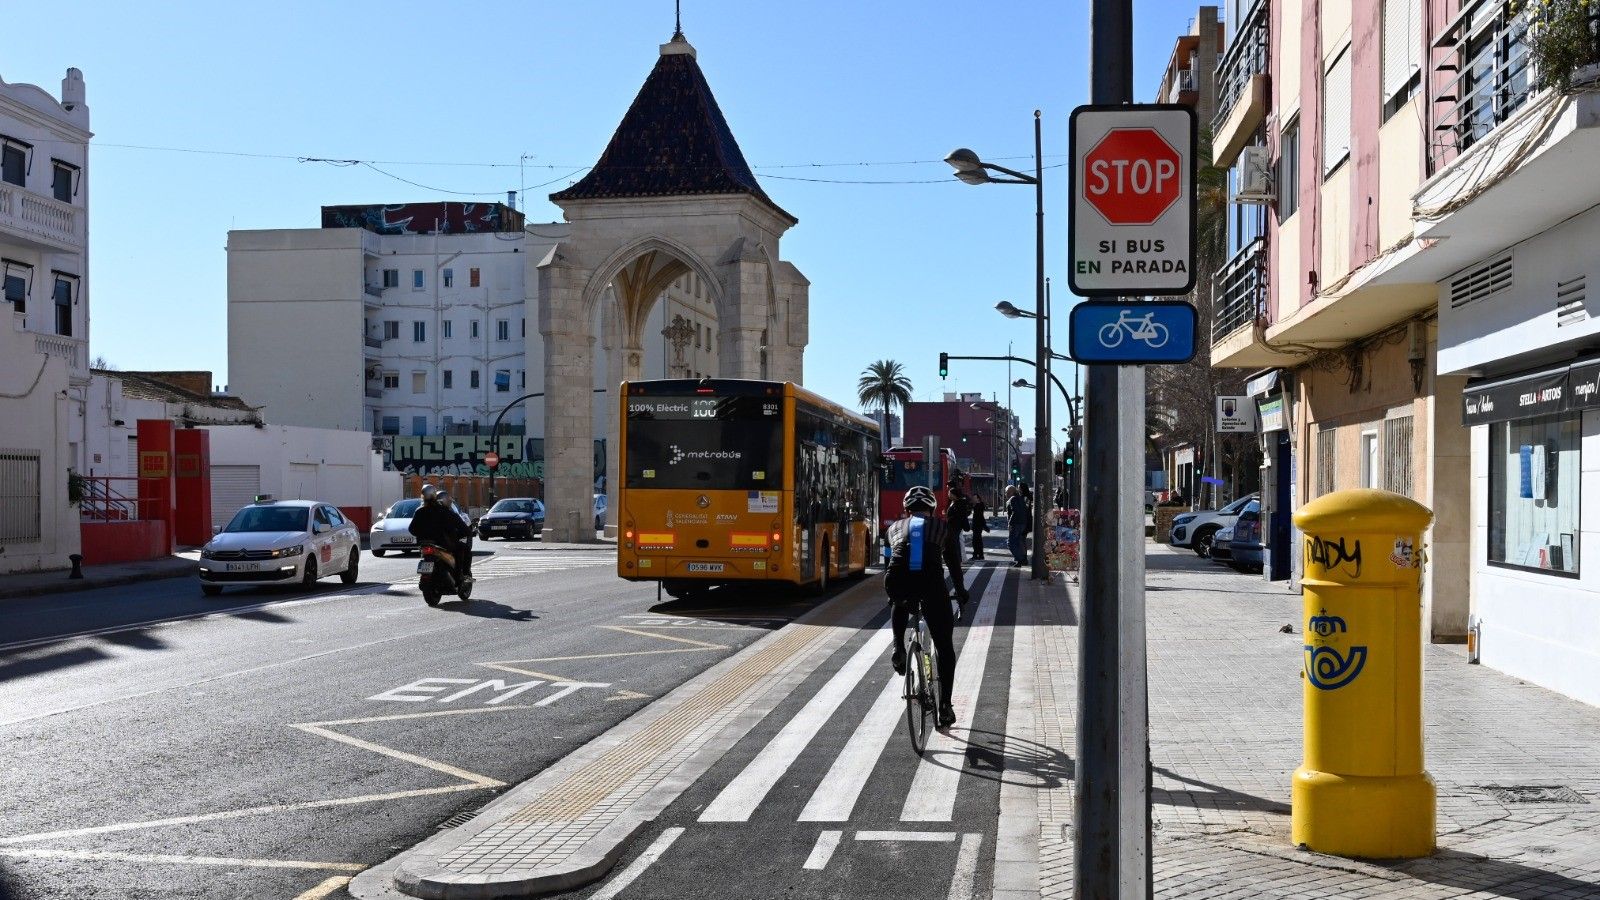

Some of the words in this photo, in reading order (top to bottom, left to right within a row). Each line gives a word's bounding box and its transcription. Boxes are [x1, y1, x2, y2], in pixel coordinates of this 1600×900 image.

[1090, 159, 1175, 195] STOP
[1099, 240, 1117, 254] SI
[1126, 239, 1165, 254] BUS
[1076, 260, 1102, 274] EN
[1111, 259, 1187, 274] PARADA
[629, 404, 654, 412] 100%
[687, 450, 742, 459] metrobús
[365, 677, 612, 708] EMT
